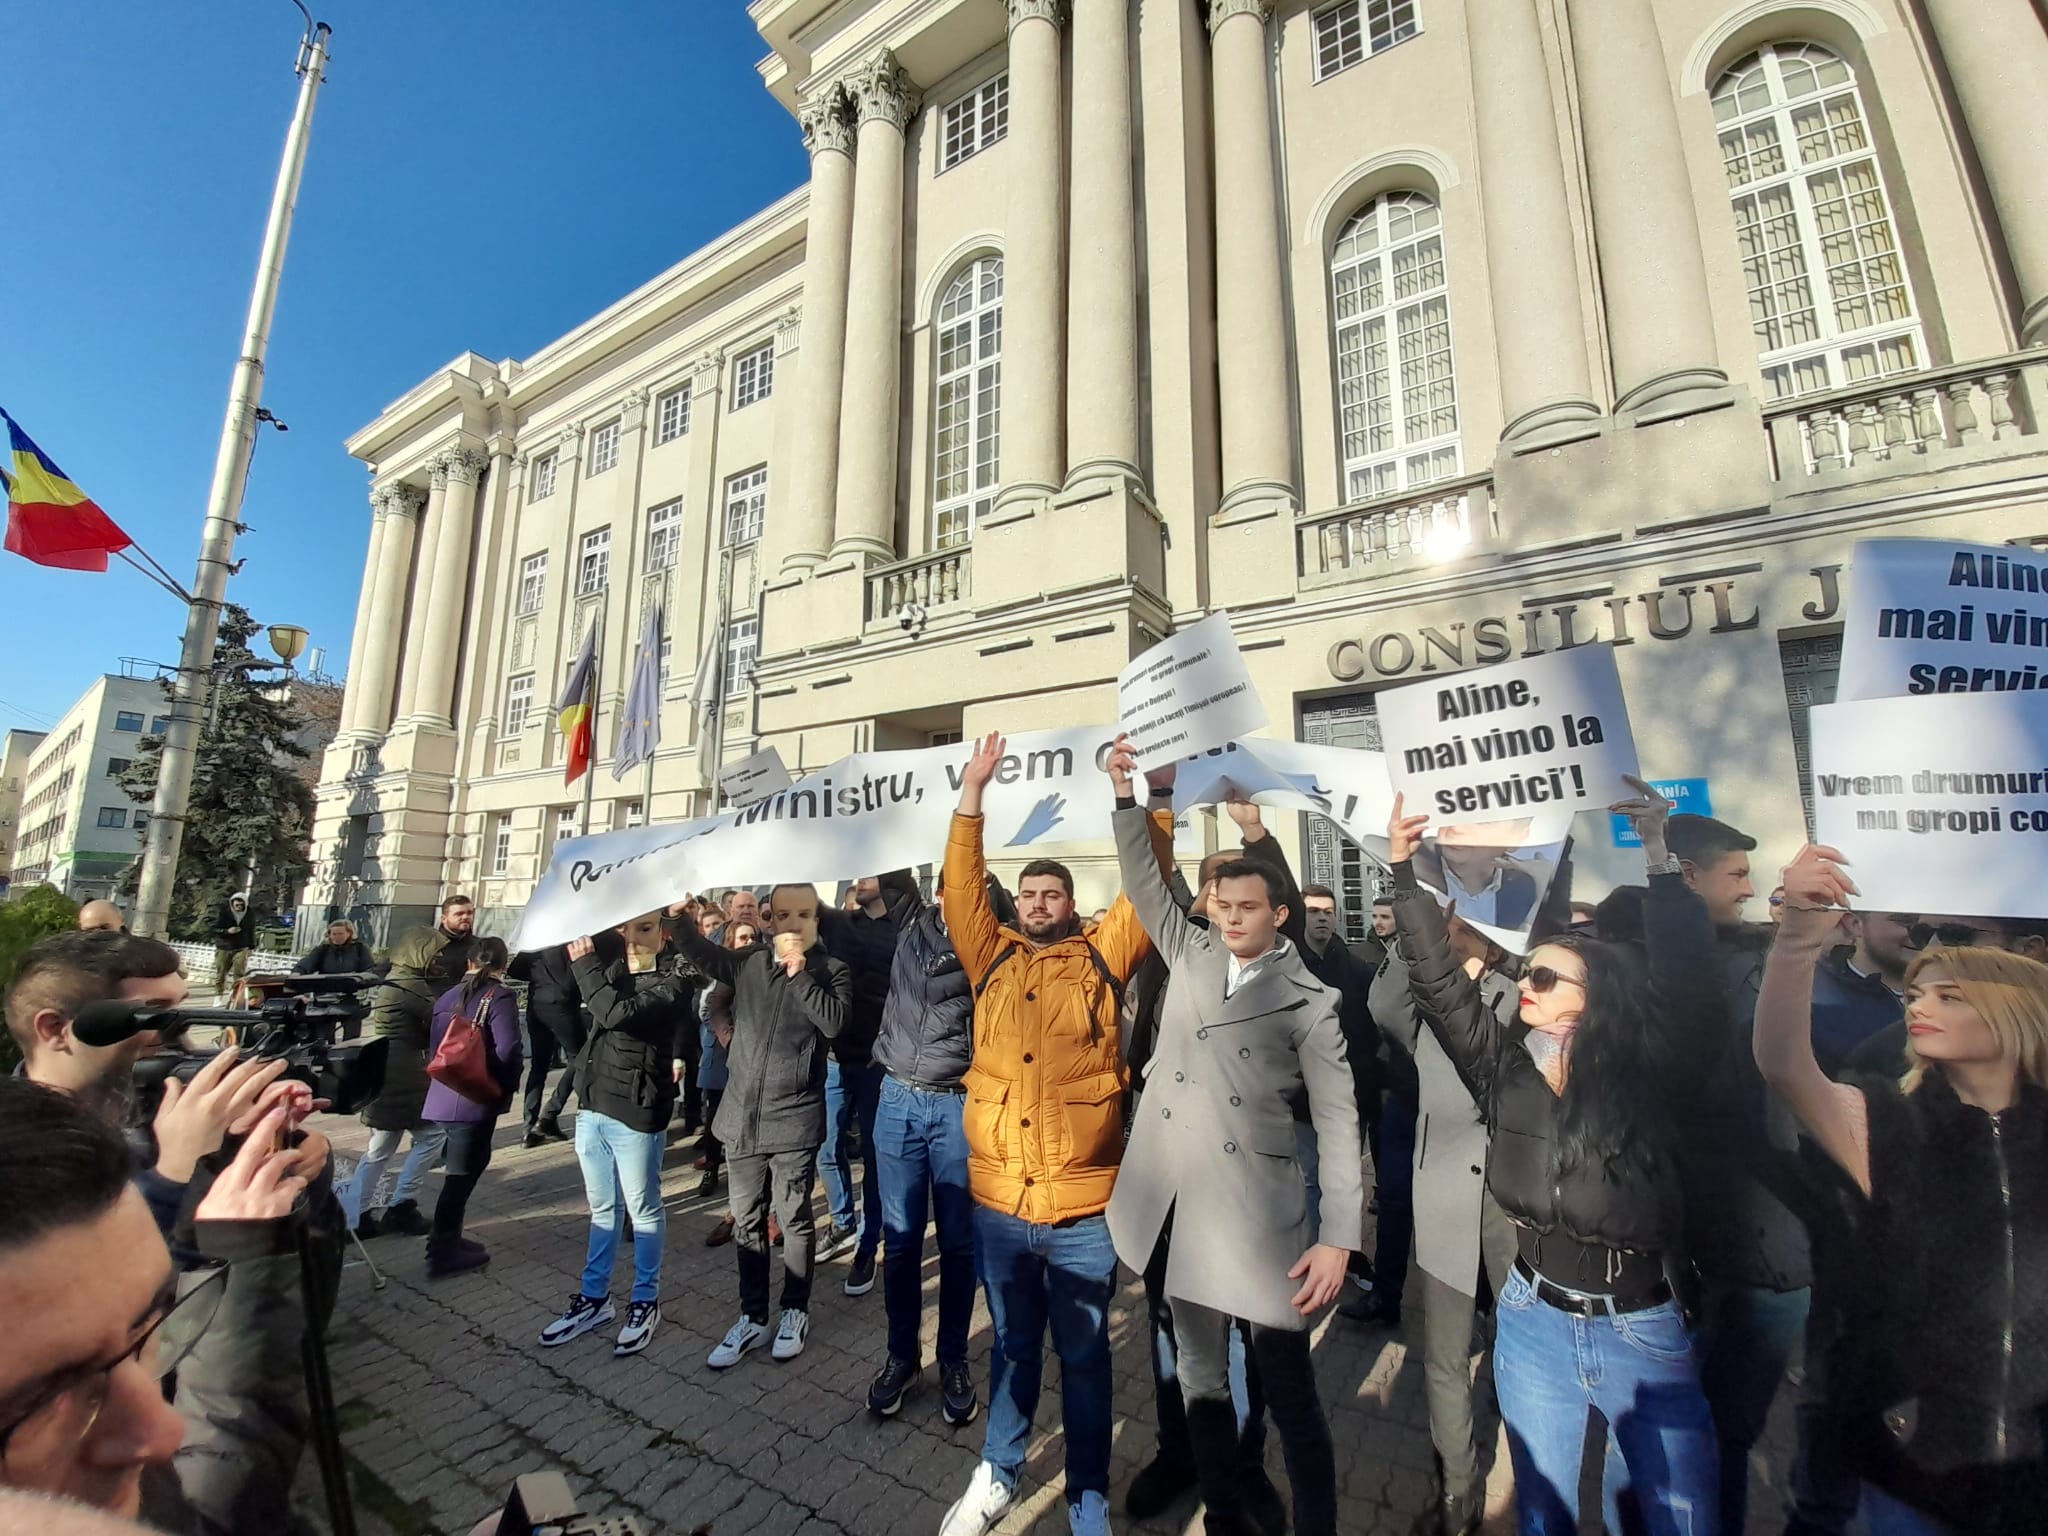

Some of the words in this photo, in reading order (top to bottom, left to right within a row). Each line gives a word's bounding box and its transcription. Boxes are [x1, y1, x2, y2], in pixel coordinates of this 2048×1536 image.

[1948, 551, 2048, 594] Alin
[1326, 580, 1760, 682] CONSILIUL
[1878, 605, 1974, 642] mai
[1436, 678, 1541, 722] Aline,
[1908, 663, 2048, 695] servi
[1404, 736, 1467, 774] mai
[1471, 723, 1555, 763] vino
[1561, 714, 1605, 748] la
[945, 747, 1073, 791] vem
[1817, 773, 1903, 797] Vrem
[1856, 809, 1898, 830] nu
[1906, 806, 2001, 835] gropi
